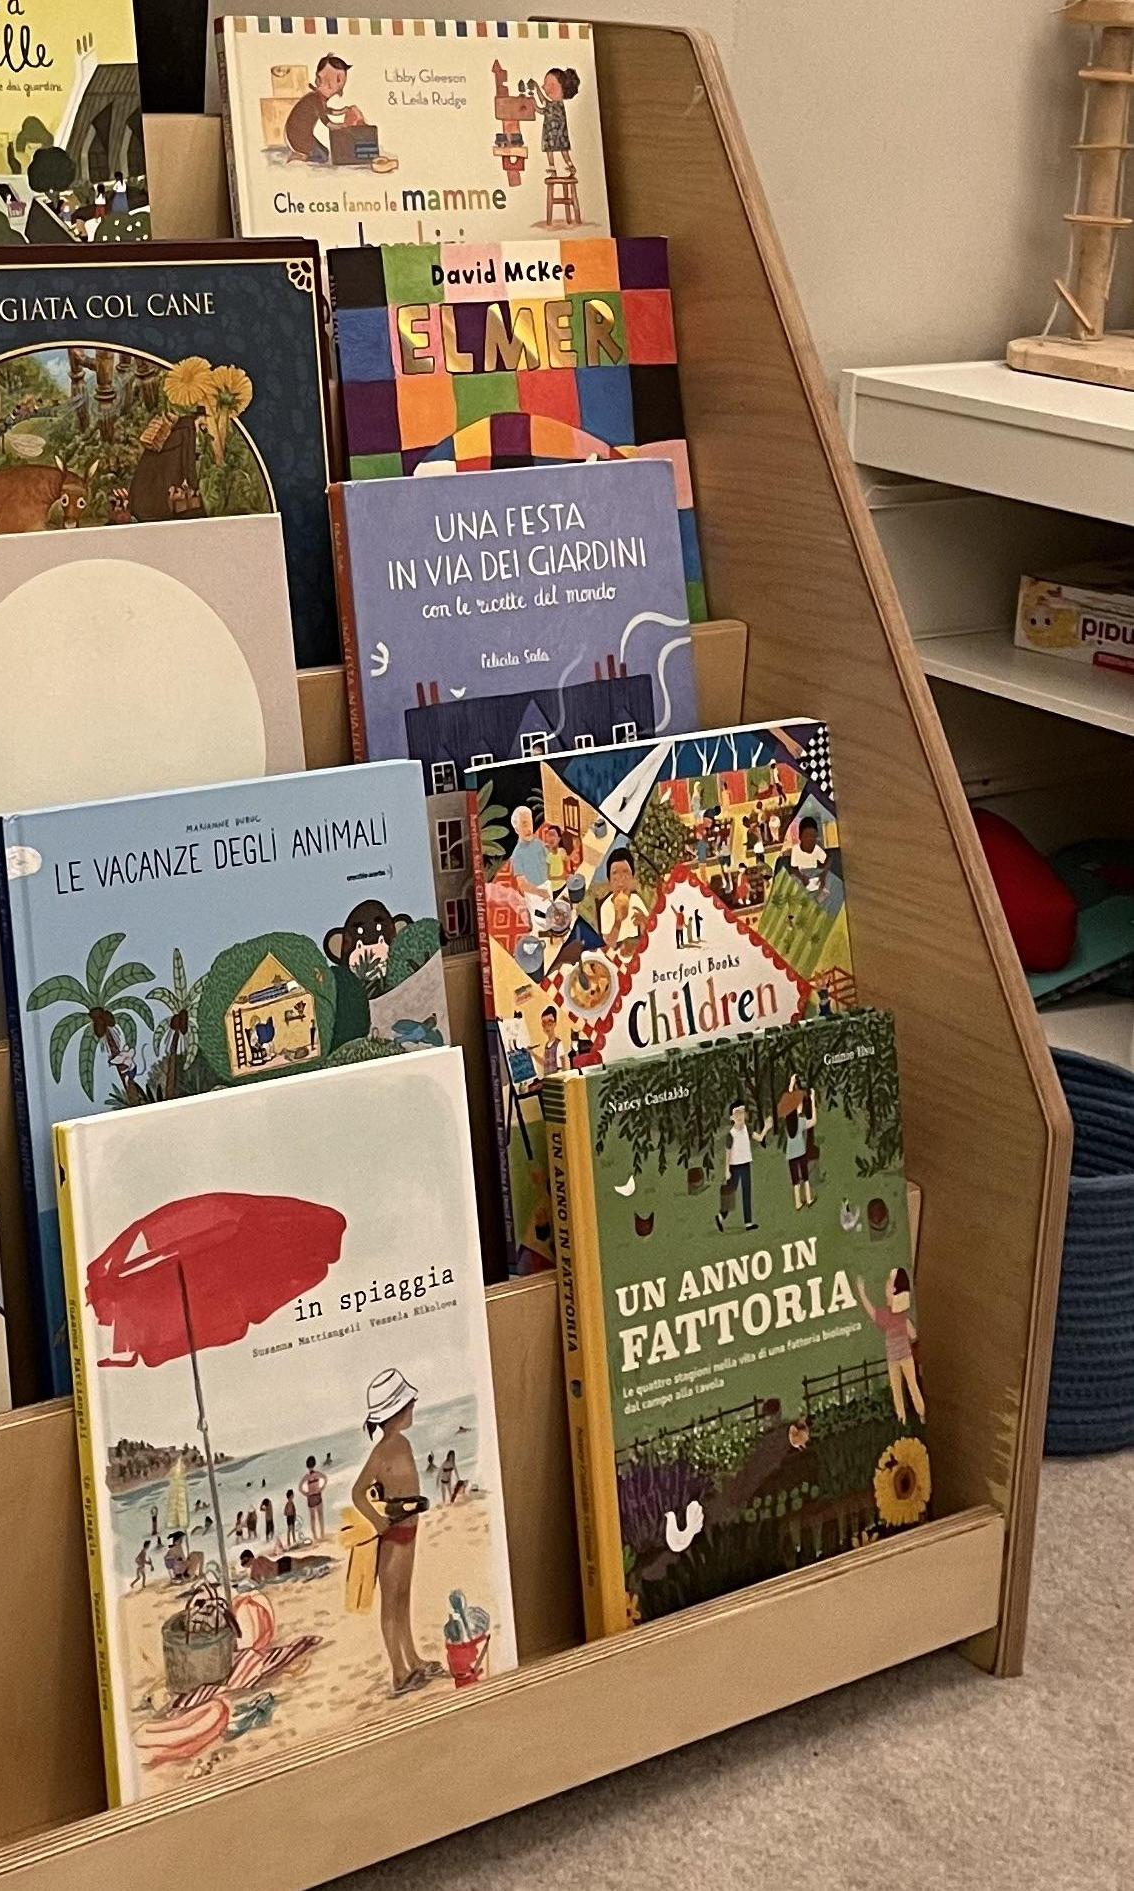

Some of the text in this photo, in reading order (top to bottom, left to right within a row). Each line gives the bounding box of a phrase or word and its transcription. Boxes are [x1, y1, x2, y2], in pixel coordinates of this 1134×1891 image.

[384, 69, 467, 87] Libby Gleeson
[387, 91, 467, 109] & Leila Rudge
[273, 187, 508, 214] Che cosa fanno le mamme
[431, 261, 496, 287] David
[85, 293, 139, 321] COL
[146, 291, 216, 317] CANE
[395, 299, 624, 376] ELMER
[434, 502, 586, 543] UNA FESTA
[387, 536, 647, 591] IN VIA DEI GIARDINI
[421, 582, 618, 620] con le ricette del mondo
[523, 647, 551, 665] Sala
[54, 860, 85, 895] LE
[93, 841, 203, 890] VACANZE
[653, 954, 741, 984] Barefoot Books
[628, 975, 779, 1049] Children
[608, 1097, 642, 1114] Nancy
[552, 1132, 580, 1354] UN ANNO IN FATTORIA
[294, 1265, 456, 1323] in spiaggia
[614, 1235, 819, 1317] UN ANNO IN
[252, 1340, 294, 1359] Susanna
[369, 1310, 410, 1329] Vessela
[617, 1268, 859, 1373] FATTORIA
